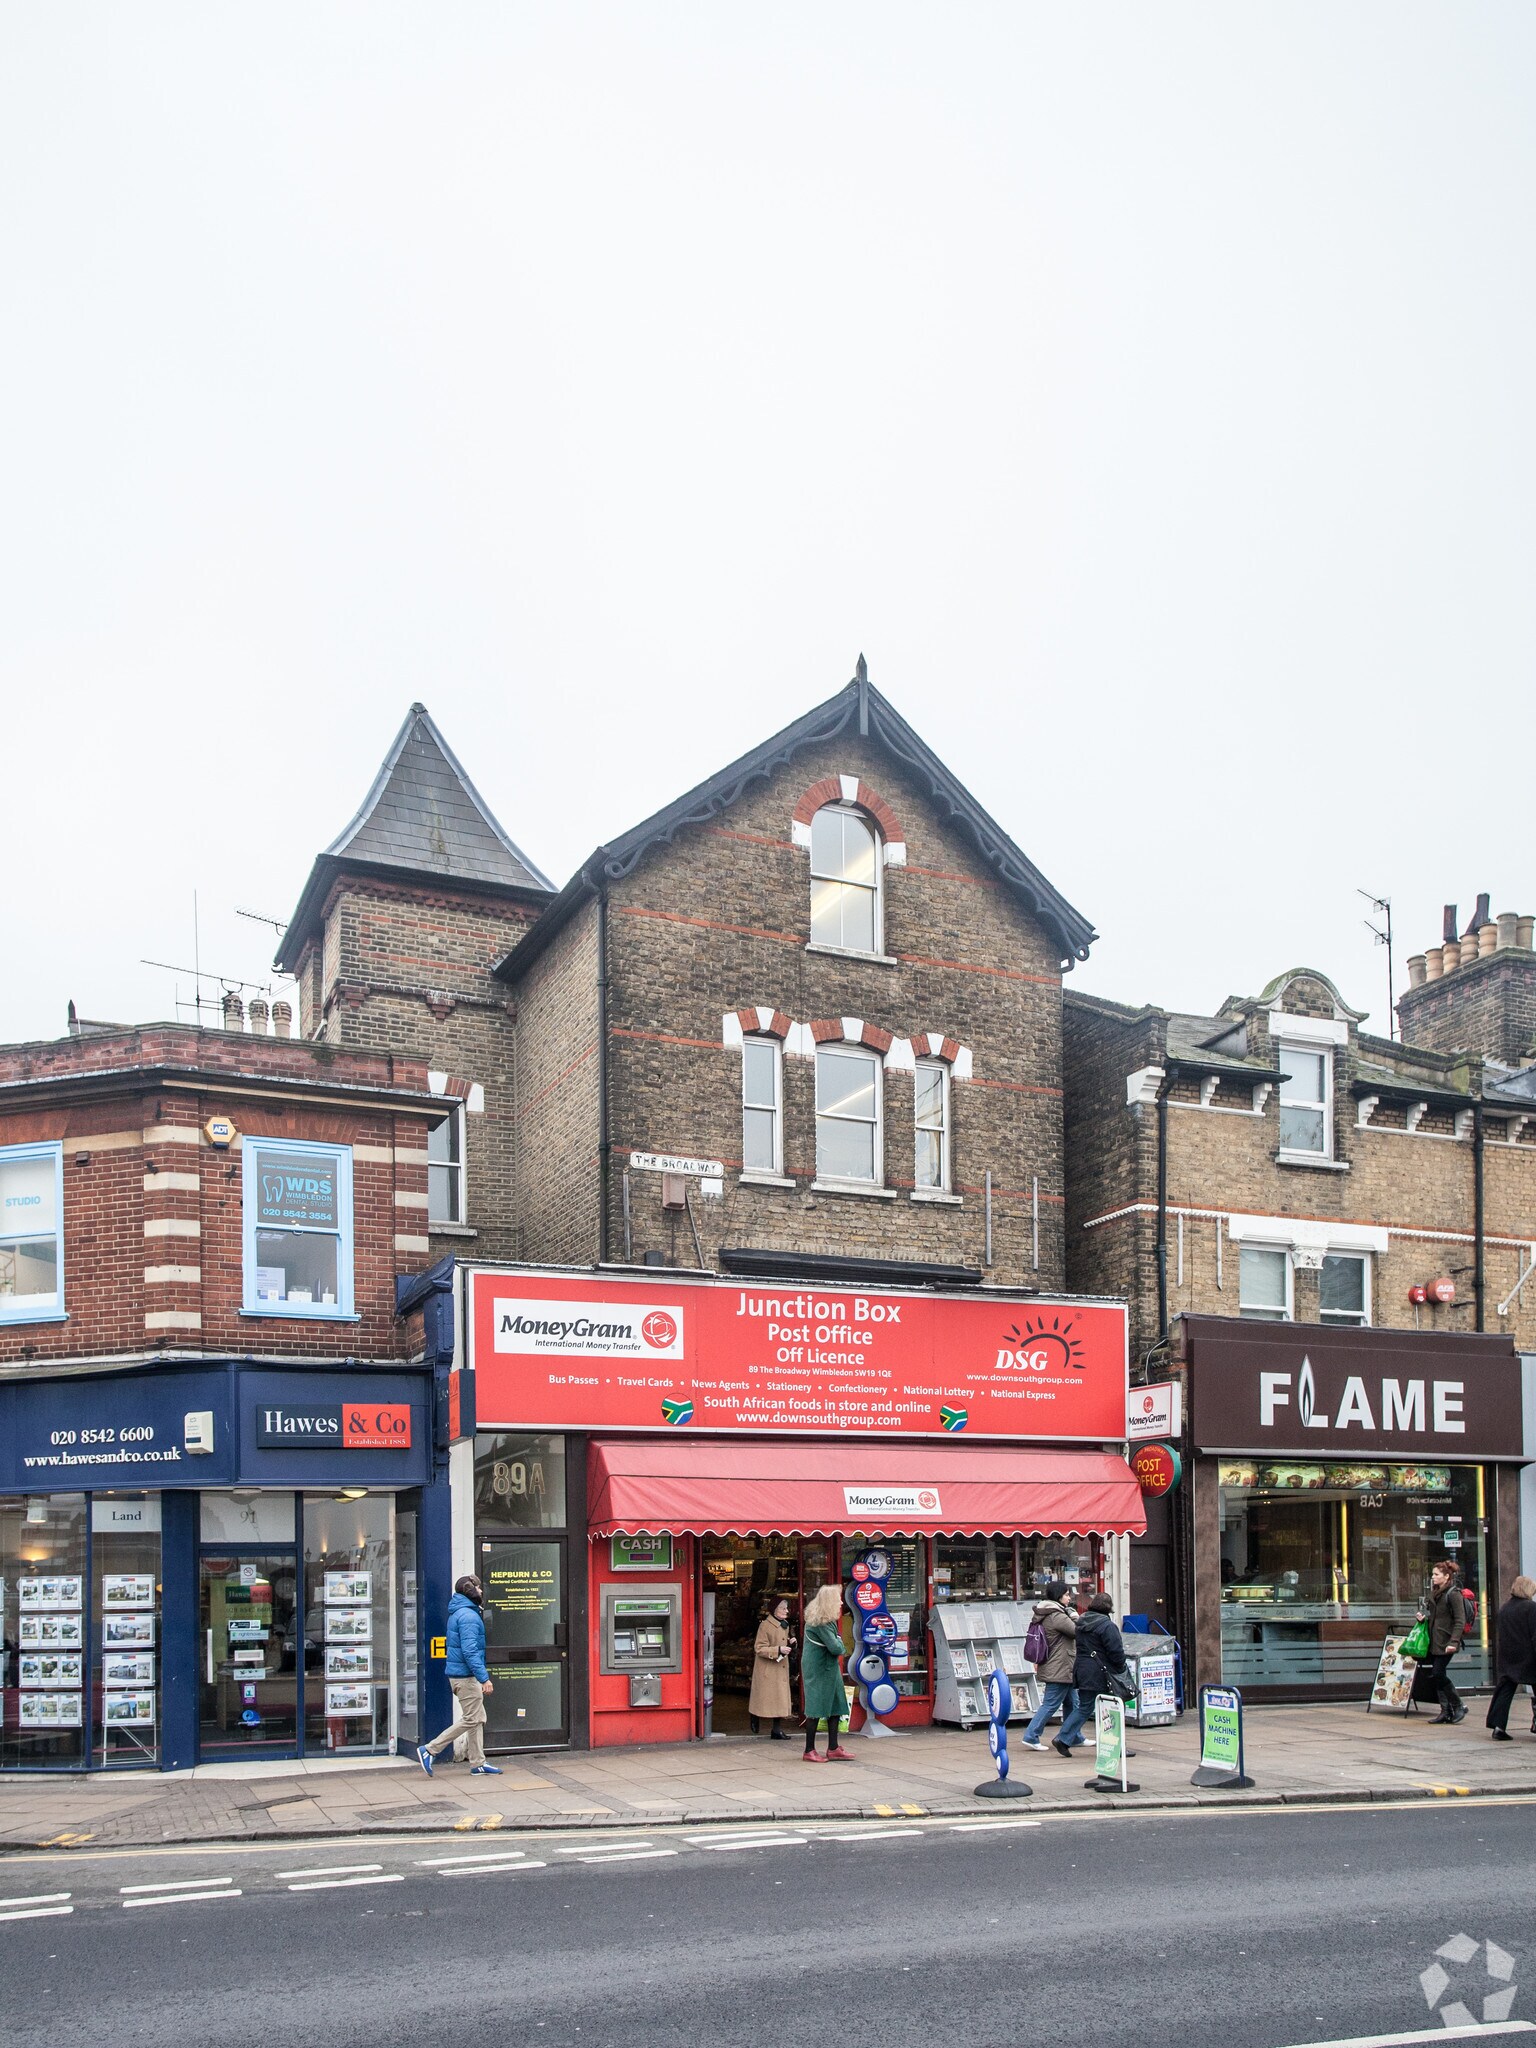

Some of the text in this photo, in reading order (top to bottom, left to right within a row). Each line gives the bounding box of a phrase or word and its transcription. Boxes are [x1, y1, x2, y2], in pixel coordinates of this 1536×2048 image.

[213, 1125, 228, 1134] ADT
[635, 1155, 716, 1174] THE BROADWAY
[285, 1176, 332, 1195] WDS
[5, 1195, 41, 1207] STUDIO
[285, 1191, 332, 1202] WIMBLEDON
[285, 1198, 332, 1208] DENTAL STUDIO
[262, 1207, 332, 1221] 020 8542 3554
[736, 1292, 902, 1323] Junction Box
[500, 1314, 632, 1340] MoneyGram
[768, 1323, 873, 1345] Post Office
[535, 1339, 641, 1351] International Money Transfer
[776, 1347, 865, 1365] Off Licence
[993, 1349, 1048, 1371] DSG
[748, 1365, 893, 1378] 89 The Broadway Wimbledon SW19 1QE
[966, 1373, 1083, 1385] www.downsouthgroup.com
[548, 1374, 1056, 1401] Bus Passes Travel Cards News Agents Stationery Confectionery National Lottery National Express
[1260, 1354, 1465, 1433] FLAME
[703, 1396, 931, 1413] South African foods in store and online
[264, 1410, 407, 1434] Hawes & Co
[736, 1411, 902, 1428] www.downsouthgroup.com
[1128, 1413, 1167, 1426] MoneyGram
[50, 1426, 154, 1445] 020 8542 6600
[24, 1446, 182, 1467] www.hawesandco.co.uk
[1137, 1458, 1162, 1472] POST
[493, 1462, 546, 1495] 89A
[849, 1495, 915, 1507] MoneyGram
[112, 1510, 142, 1521] Land
[240, 1510, 257, 1524] 91
[620, 1539, 662, 1550] CASH
[1141, 1670, 1173, 1679] UNLIMITED
[1213, 1714, 1231, 1724] CASH
[1208, 1724, 1237, 1736] MACHINE
[1213, 1736, 1230, 1746] HERE
